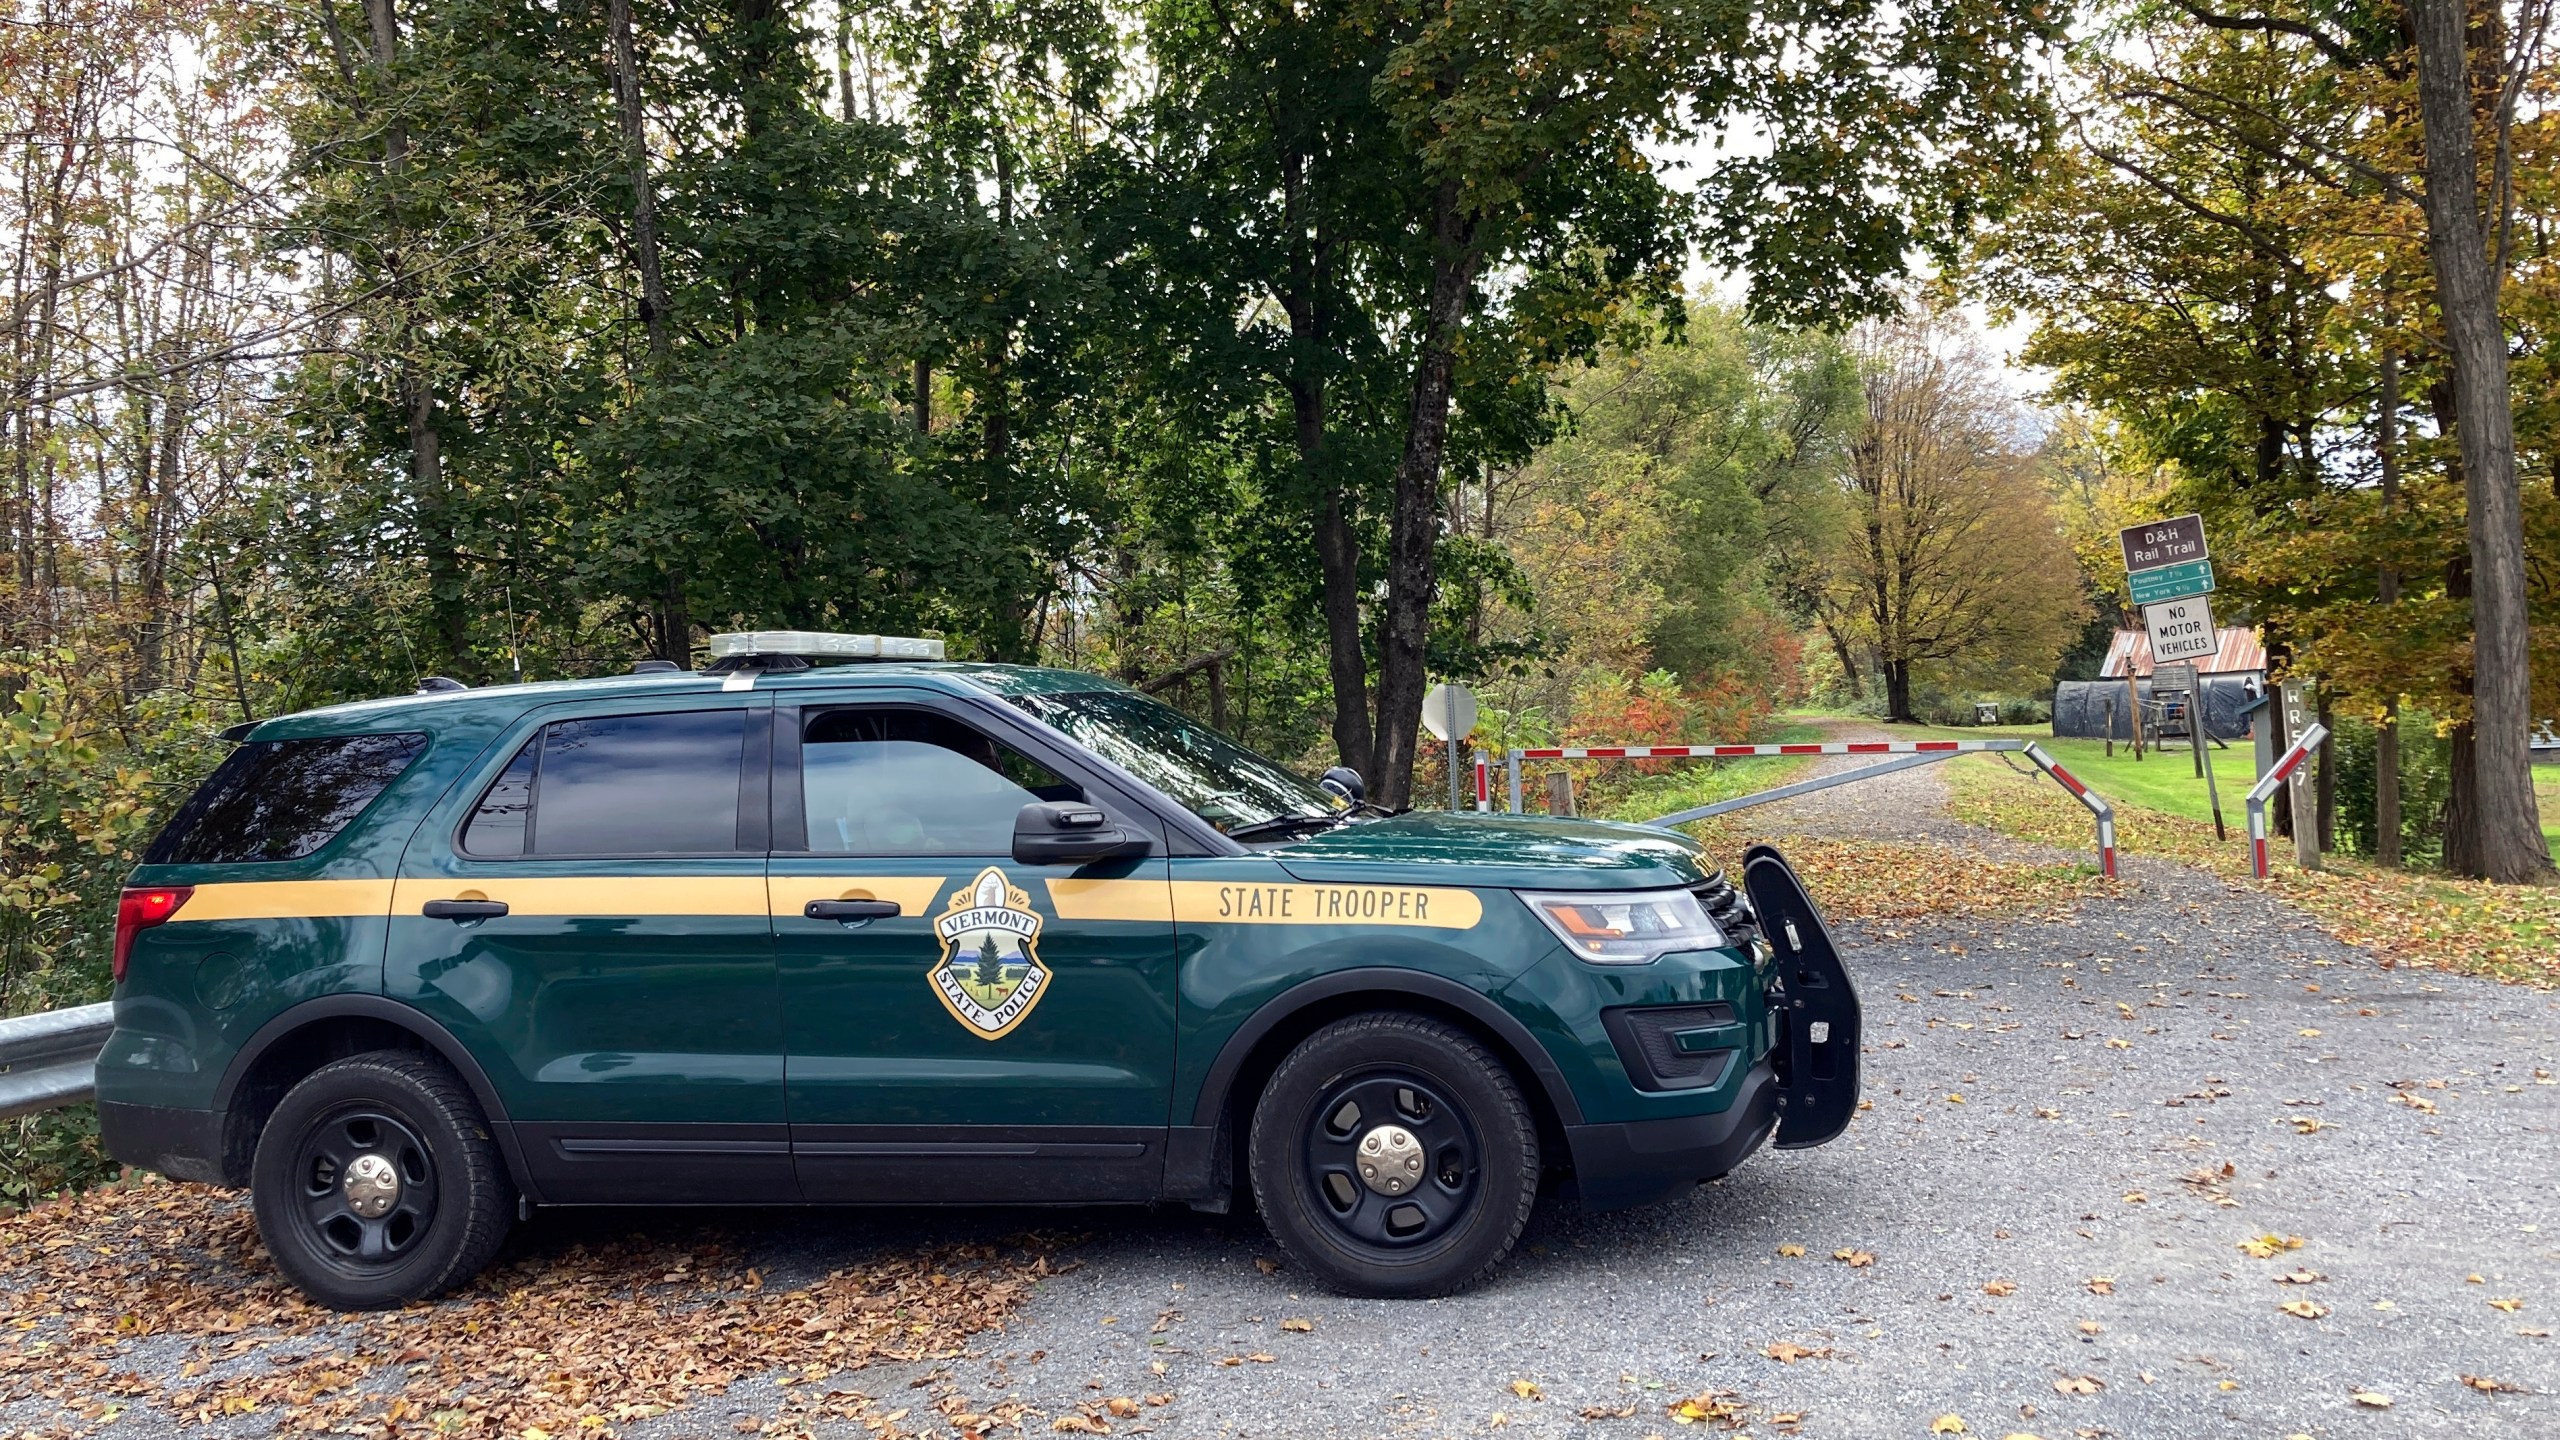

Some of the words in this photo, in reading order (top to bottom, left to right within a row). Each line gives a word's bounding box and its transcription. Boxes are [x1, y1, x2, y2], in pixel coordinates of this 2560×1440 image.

[2145, 527, 2179, 545] D&H
[2134, 548, 2159, 562] Rail
[2165, 540, 2196, 556] Trail
[2154, 588, 2171, 596] York
[2169, 606, 2186, 619] NO
[2159, 621, 2202, 639] MOTOR
[2160, 637, 2208, 655] VEHICLES
[1219, 886, 1294, 917] STATE
[1314, 889, 1429, 920] TROOPER
[945, 910, 1034, 932] VERMONT
[939, 971, 985, 1023] STATE
[994, 970, 1042, 1025] POLICE
